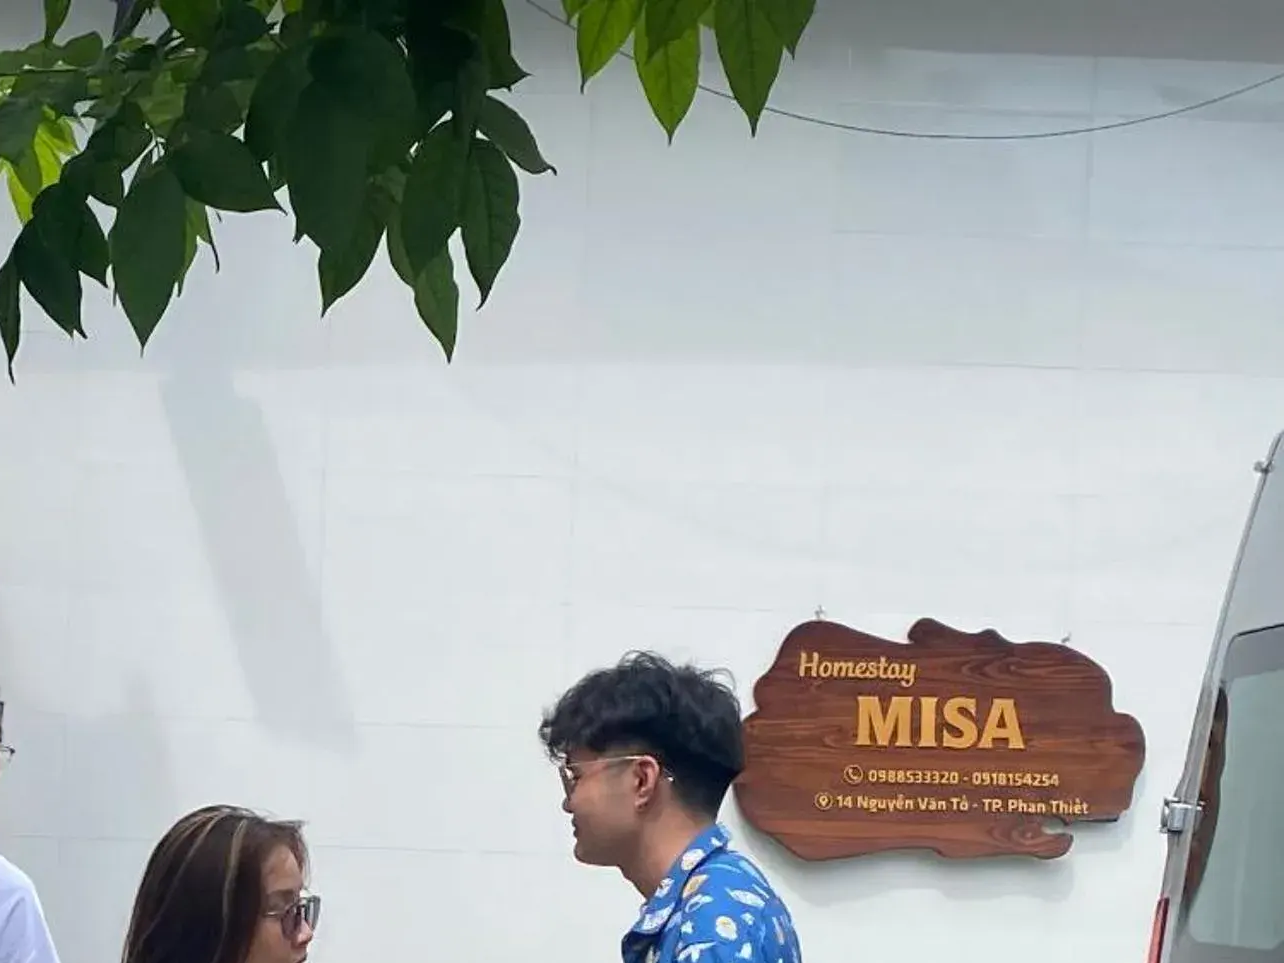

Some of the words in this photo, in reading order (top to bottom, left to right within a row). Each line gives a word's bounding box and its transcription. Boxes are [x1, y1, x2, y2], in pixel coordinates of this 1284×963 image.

[799, 652, 916, 687] Homestay
[853, 695, 1025, 749] MISA
[868, 769, 959, 784] 0988533320
[972, 771, 1060, 787] 0918154254
[836, 794, 853, 809] 14
[1008, 799, 1046, 813] Phan
